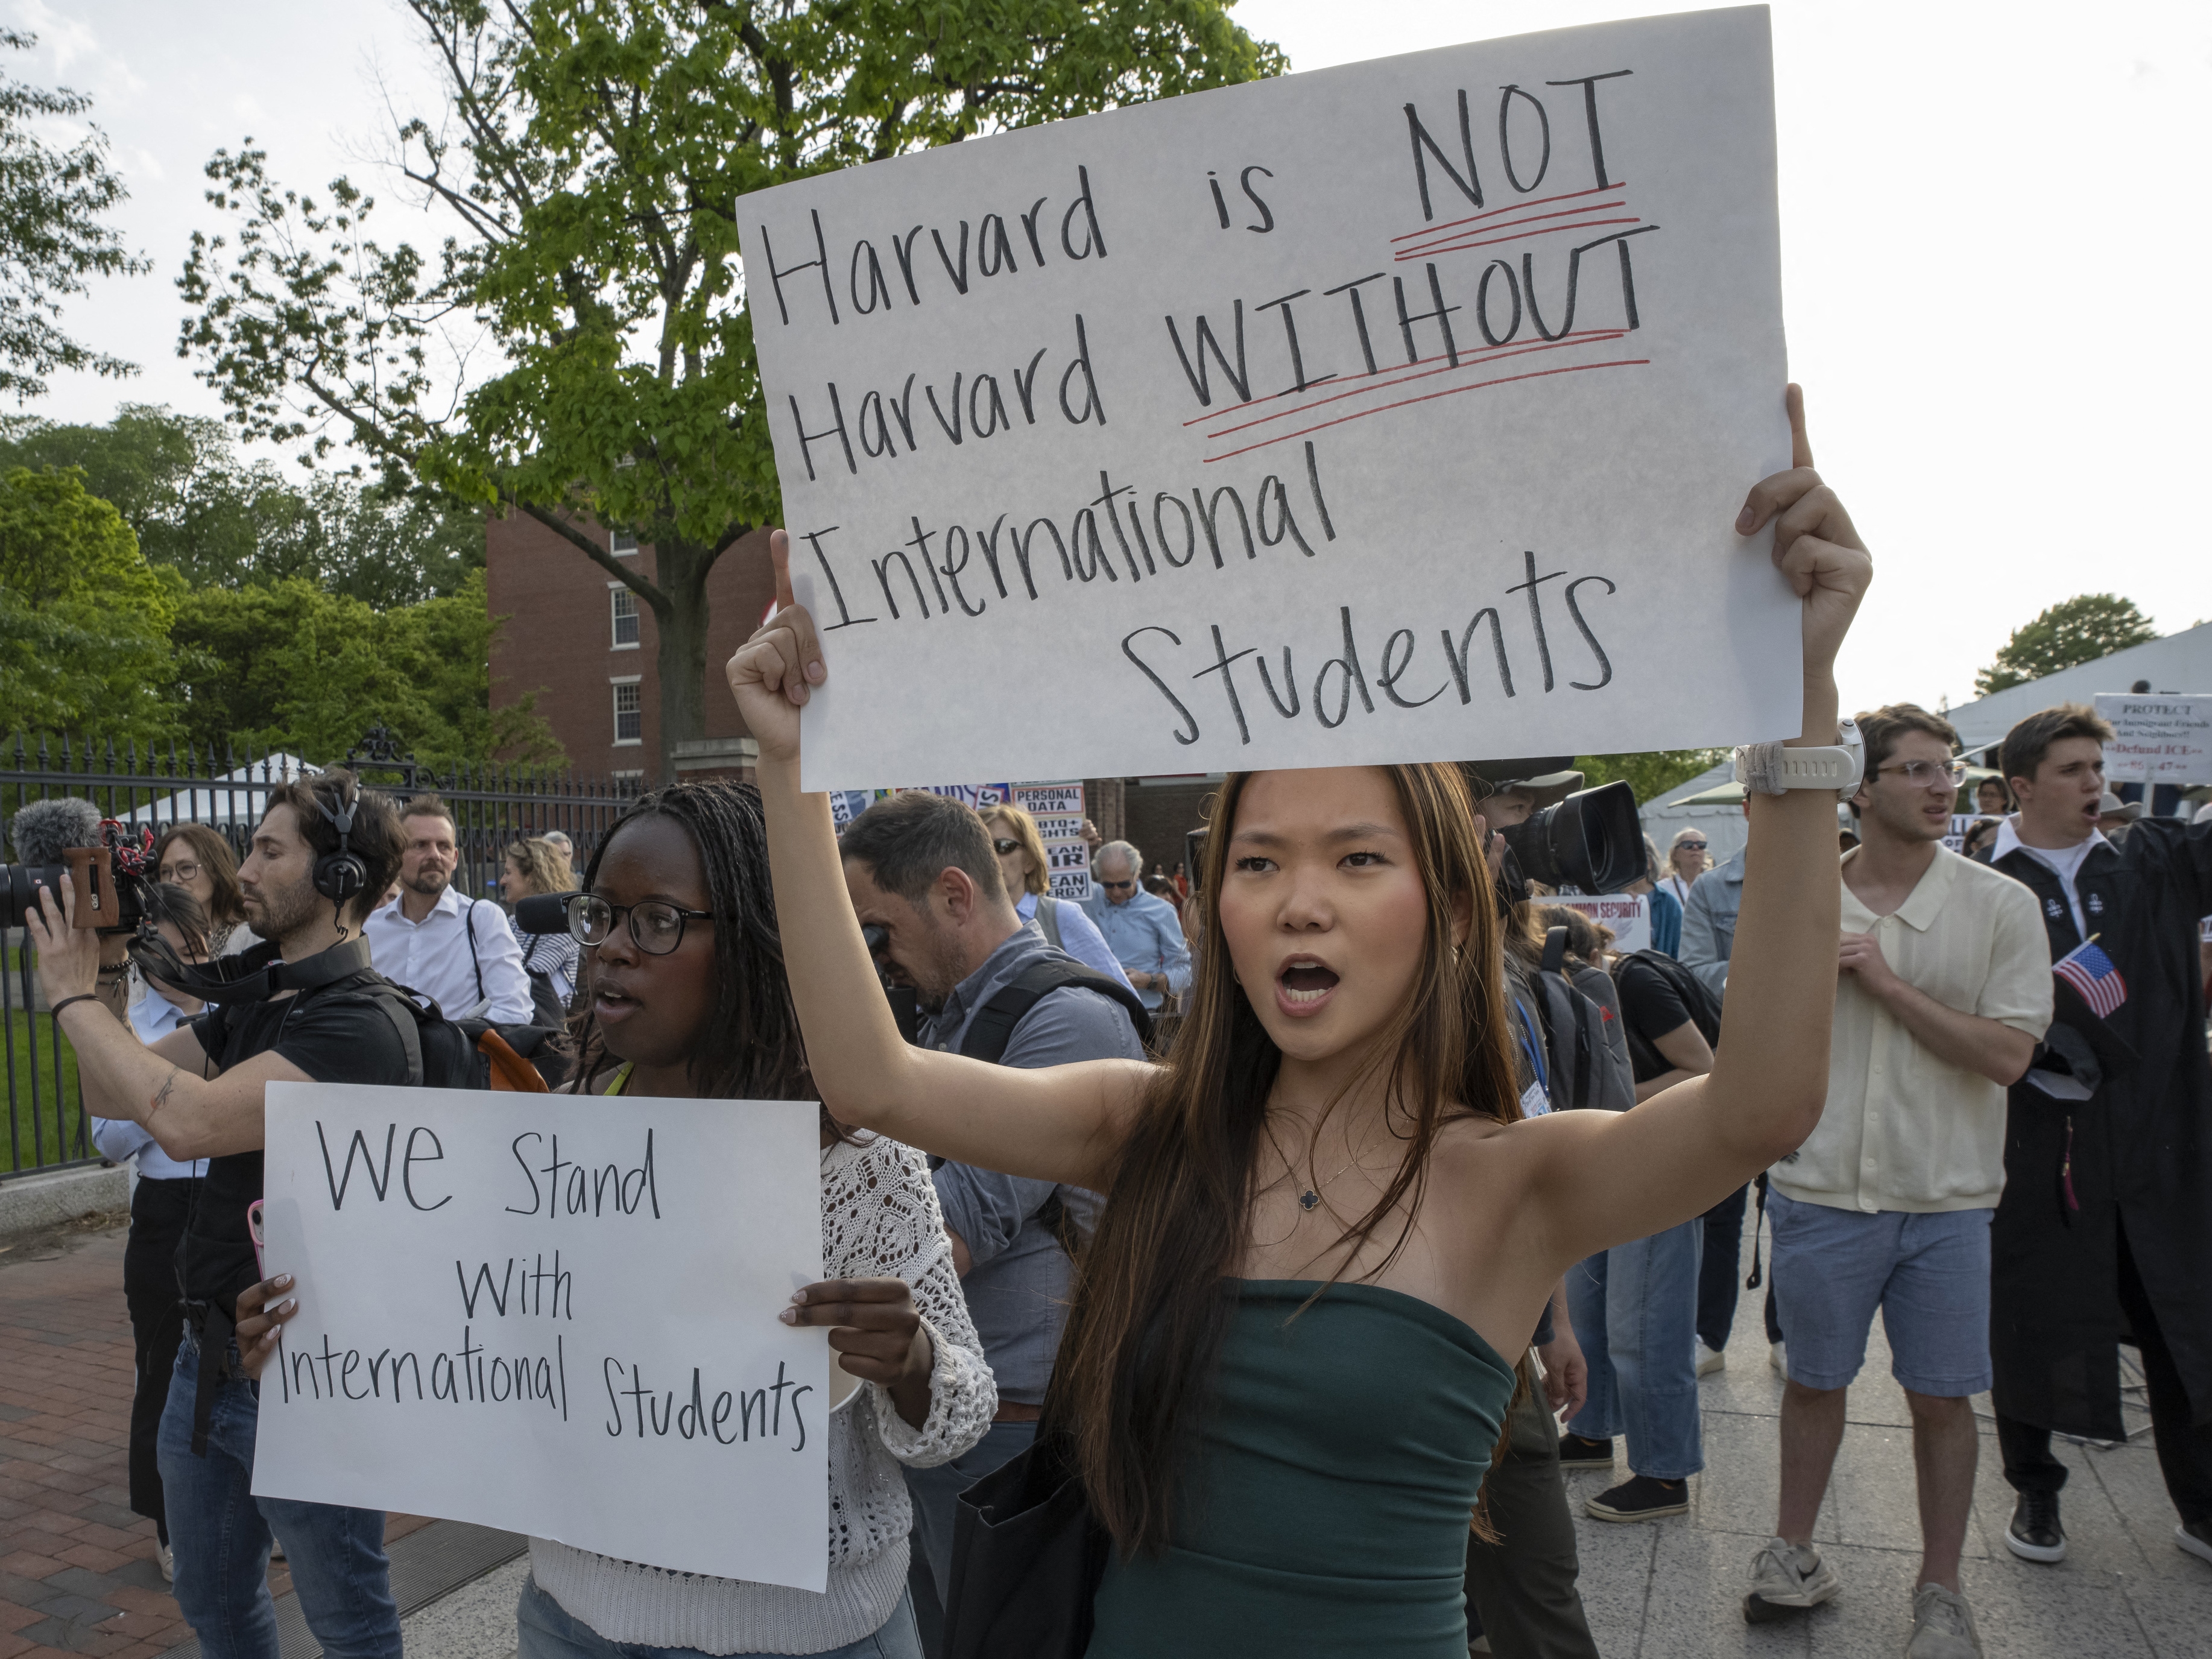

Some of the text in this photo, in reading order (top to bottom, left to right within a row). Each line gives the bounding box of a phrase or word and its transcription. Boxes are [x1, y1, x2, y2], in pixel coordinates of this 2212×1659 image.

[761, 69, 1633, 325] Harvard is NOT
[789, 225, 1660, 481] Harvard WITHOUT
[799, 441, 1336, 631] International
[1122, 551, 1616, 745] Students
[2123, 704, 2191, 715] PROTECT
[1017, 789, 1079, 801] PERSONAL
[1028, 801, 1066, 812] DATA
[1048, 845, 1083, 855] EAN
[1051, 854, 1083, 867] IR
[1046, 886, 1085, 897] ERGY
[1049, 874, 1084, 887] EAN
[315, 1120, 660, 1219] We Stand
[457, 1250, 572, 1321] With
[277, 1326, 813, 1452] International Students
